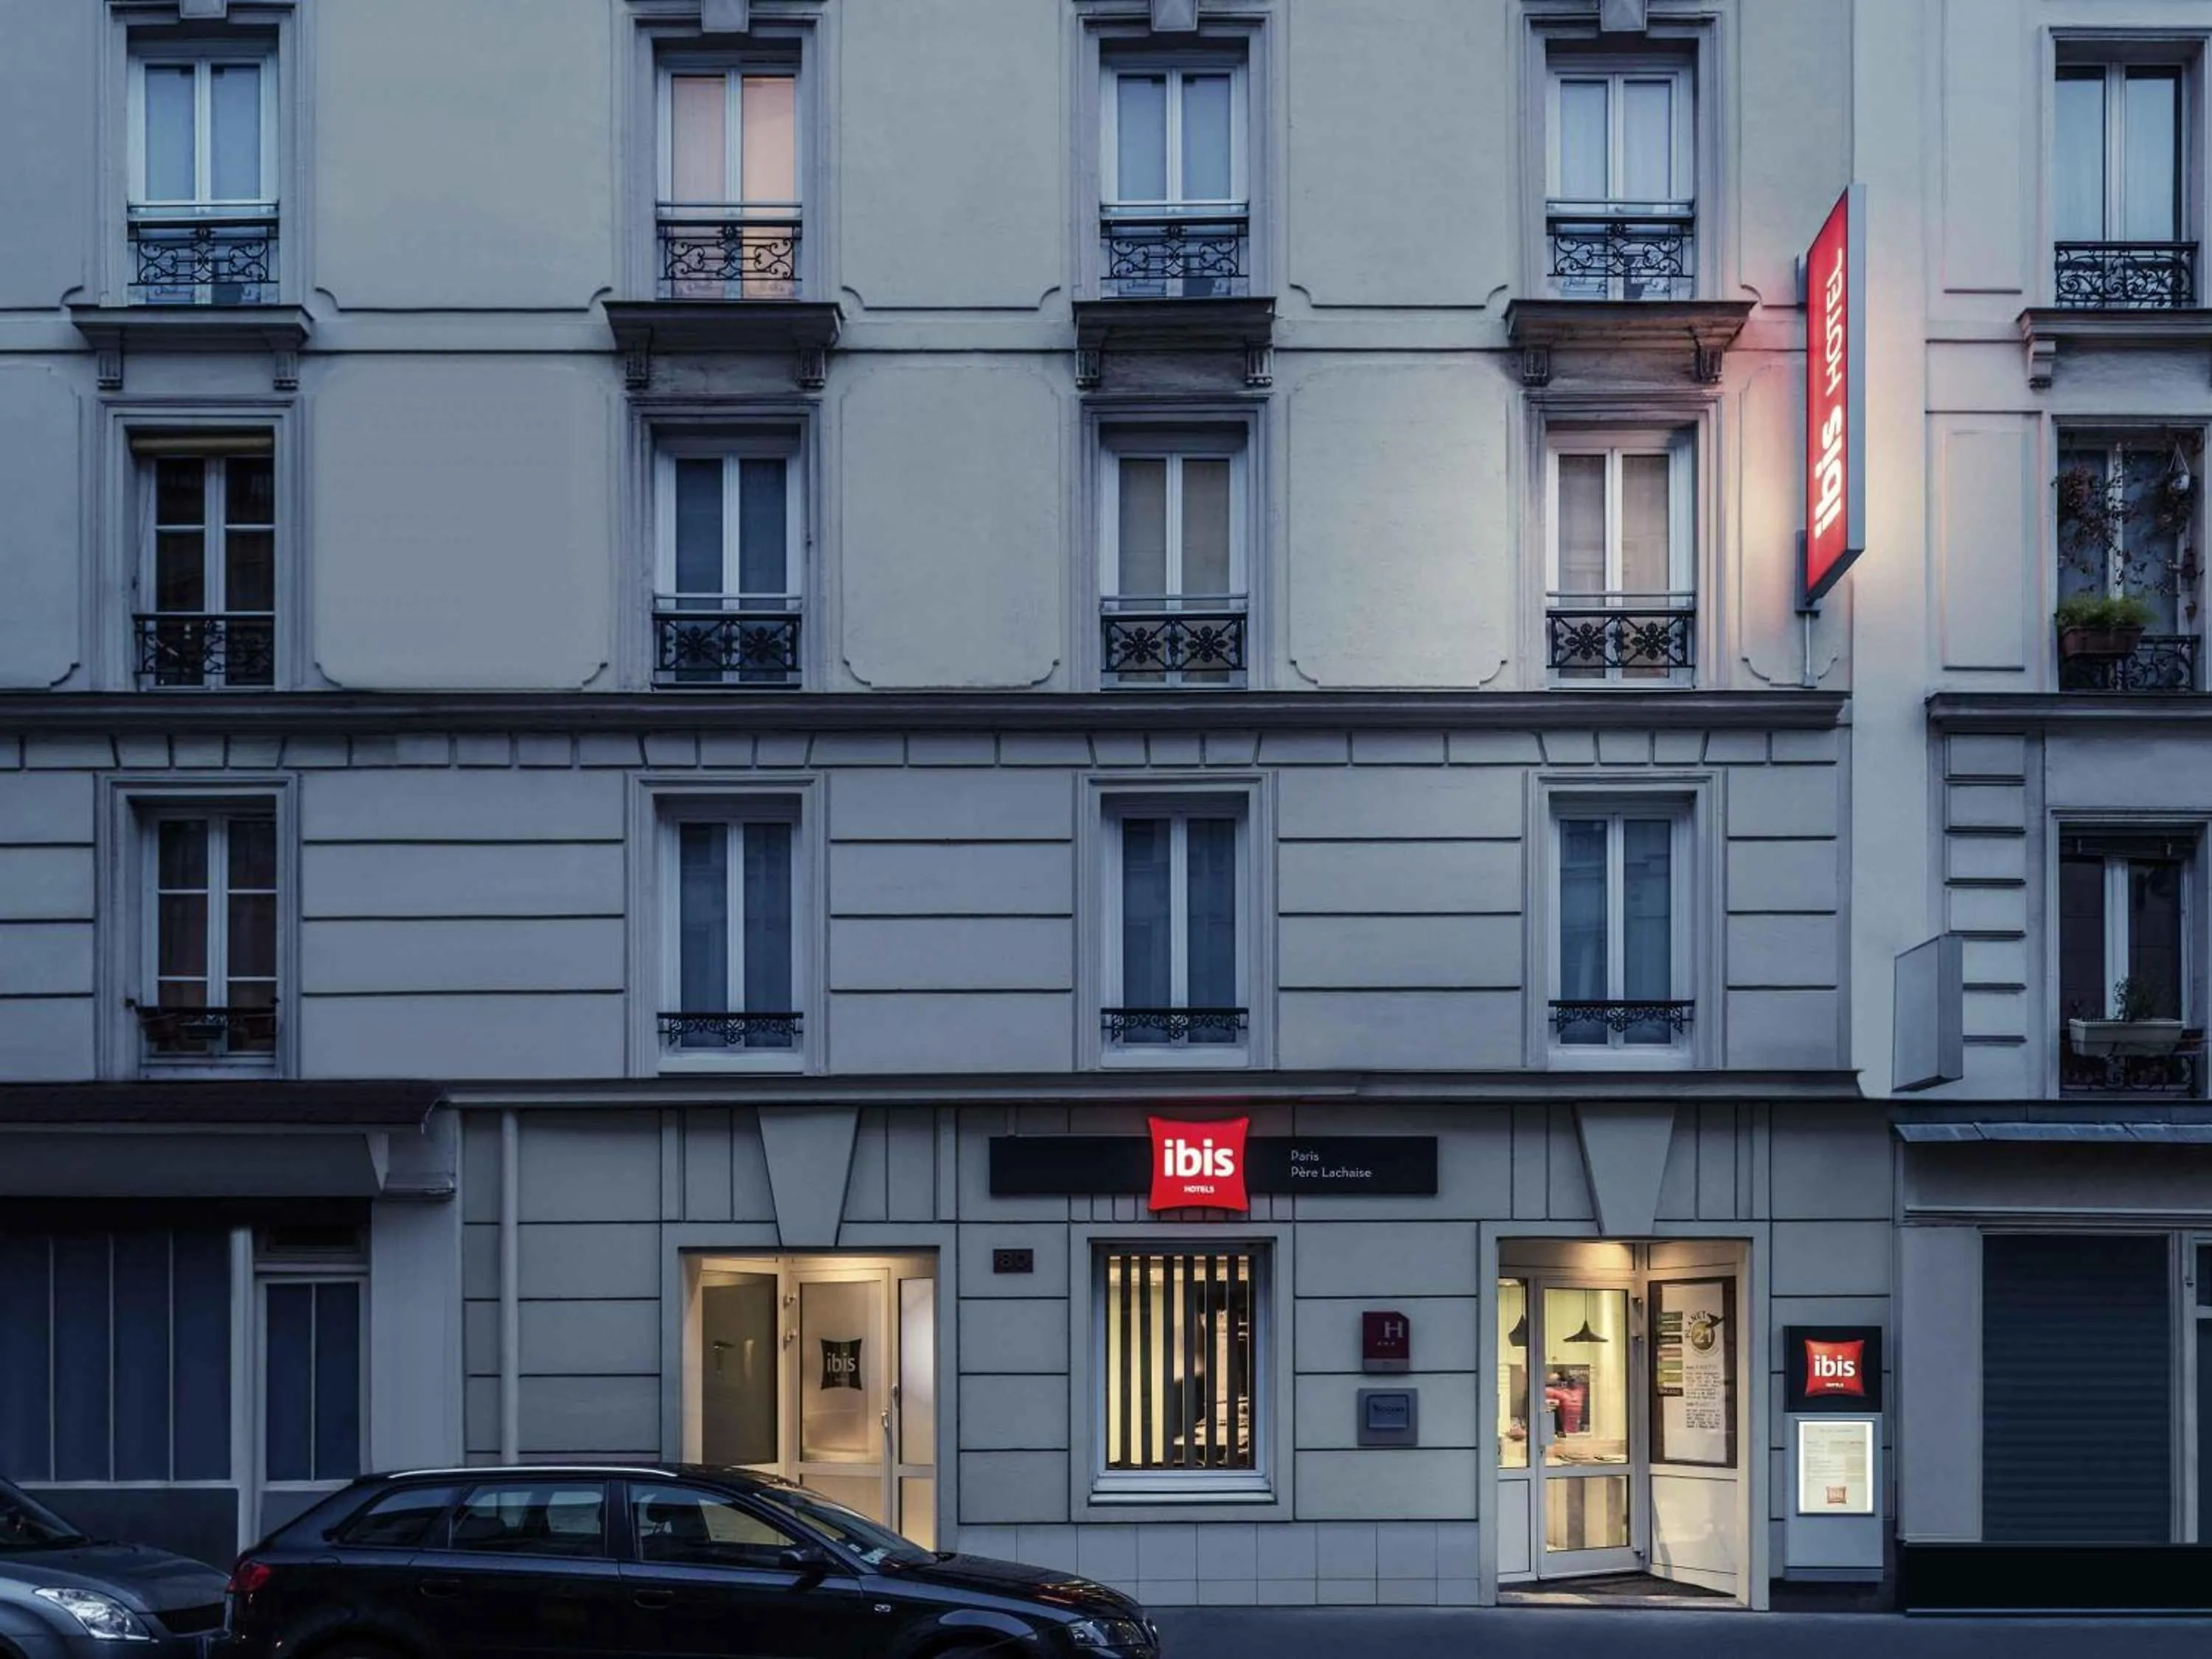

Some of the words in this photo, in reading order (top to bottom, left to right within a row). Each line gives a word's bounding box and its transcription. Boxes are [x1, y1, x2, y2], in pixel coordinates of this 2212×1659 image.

[1826, 247, 1843, 397] HOTEL
[1815, 404, 1843, 540] ibis
[1164, 1138, 1235, 1178] ibis
[1291, 1150, 1319, 1161] Paris
[1291, 1166, 1319, 1178] Père
[1321, 1166, 1372, 1178] Lachaise
[1183, 1185, 1215, 1194] HOTELS
[1383, 1321, 1404, 1338] H
[827, 1352, 856, 1372] ibis
[1814, 1354, 1856, 1377] ibis
